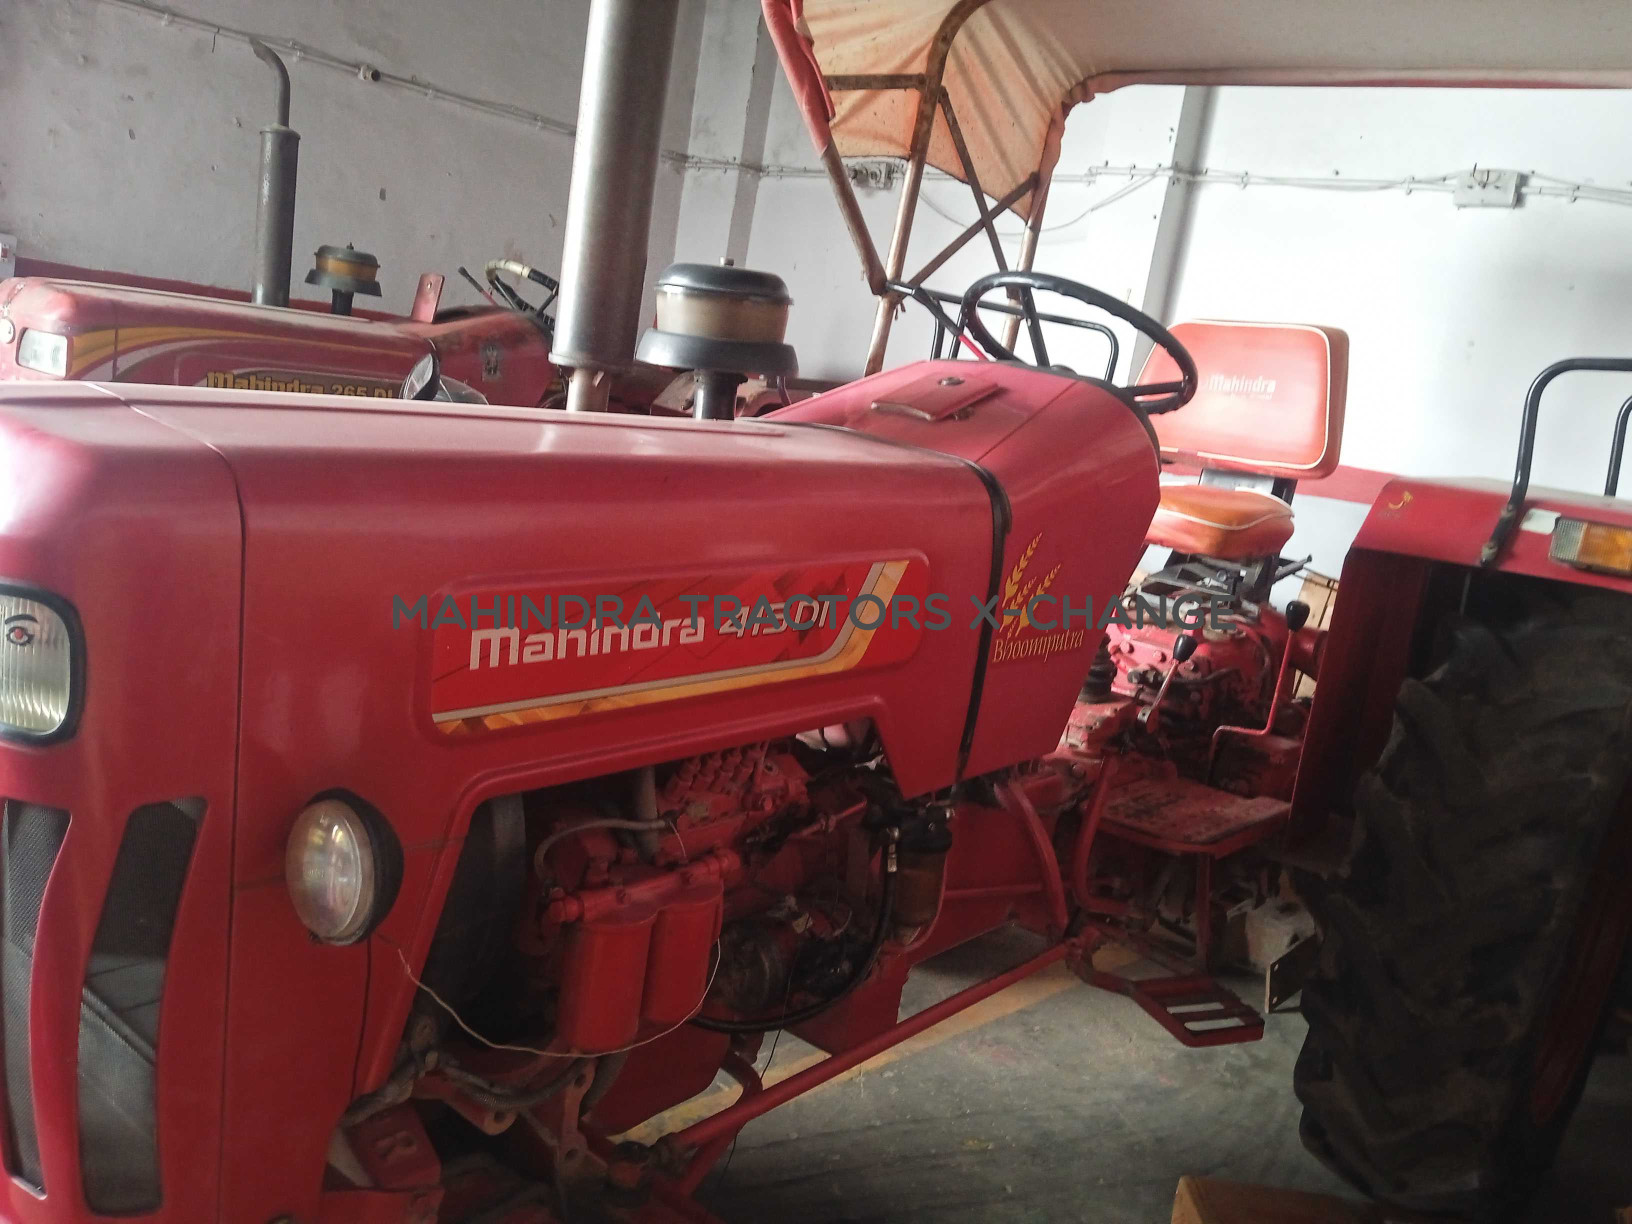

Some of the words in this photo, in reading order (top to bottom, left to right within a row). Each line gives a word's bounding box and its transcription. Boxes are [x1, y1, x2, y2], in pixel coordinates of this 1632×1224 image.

[1208, 375, 1277, 392] Mahindra
[469, 612, 705, 670] Mahindra
[992, 628, 1084, 663] Bhoomiputra
